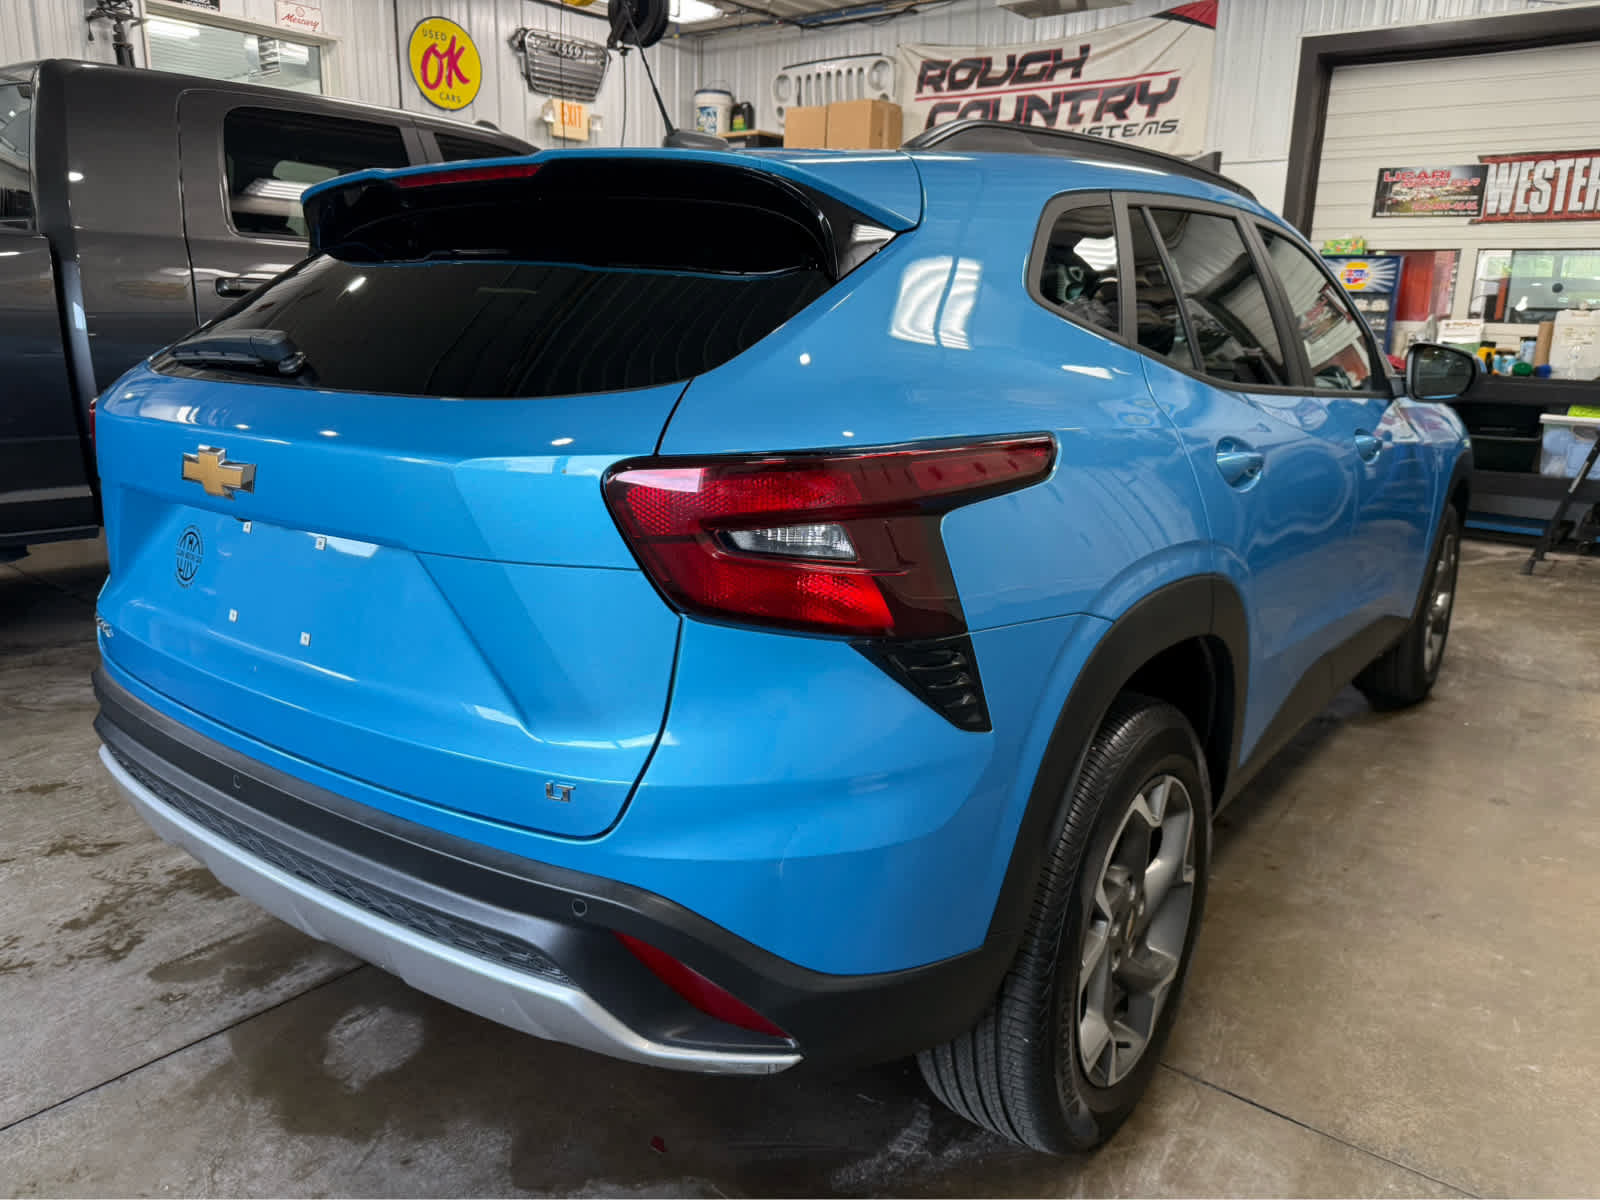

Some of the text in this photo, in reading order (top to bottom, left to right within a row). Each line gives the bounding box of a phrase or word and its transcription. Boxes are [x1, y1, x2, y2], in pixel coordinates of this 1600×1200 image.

[282, 13, 320, 32] Mercury
[422, 27, 447, 42] USED
[421, 34, 471, 90] OK
[915, 44, 1090, 94] ROUGH
[440, 92, 462, 104] CARS
[925, 77, 1181, 130] COUNTRY
[560, 102, 583, 129] EXIT
[545, 781, 576, 803] LT
